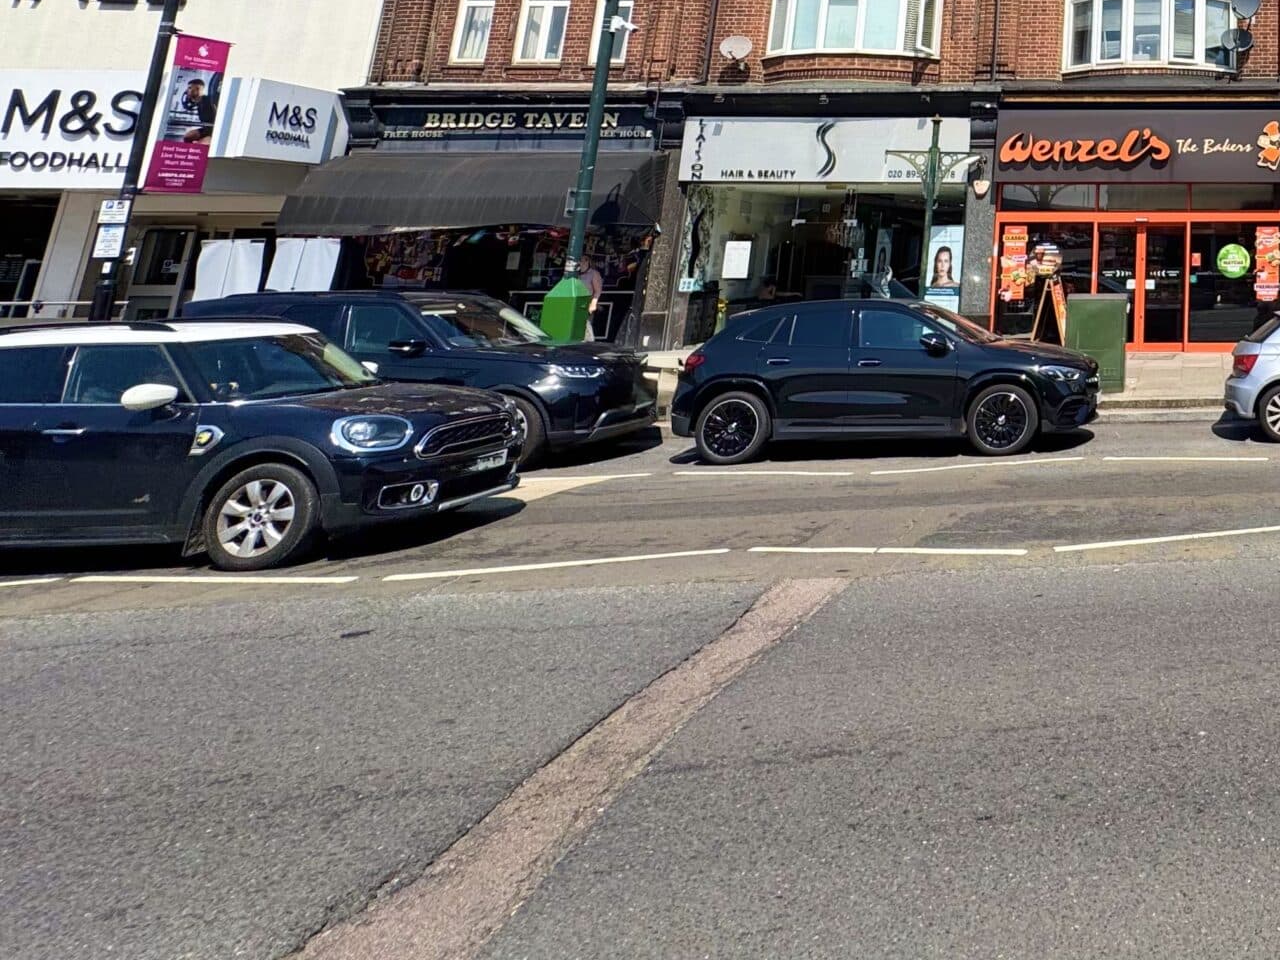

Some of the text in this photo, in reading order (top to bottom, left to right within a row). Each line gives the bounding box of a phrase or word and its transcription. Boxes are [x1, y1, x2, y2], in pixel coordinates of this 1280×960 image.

[1, 89, 144, 135] M&S
[268, 101, 317, 129] M&S
[424, 112, 620, 128] BRIDGE TAVEN
[266, 130, 309, 144] FOODHALL
[383, 130, 443, 138] FREE HOUSE
[599, 129, 653, 137] REE HOUSE
[1000, 128, 1253, 163] Wenzel's The Bakers
[721, 170, 796, 178] HAIR & BEAUTY
